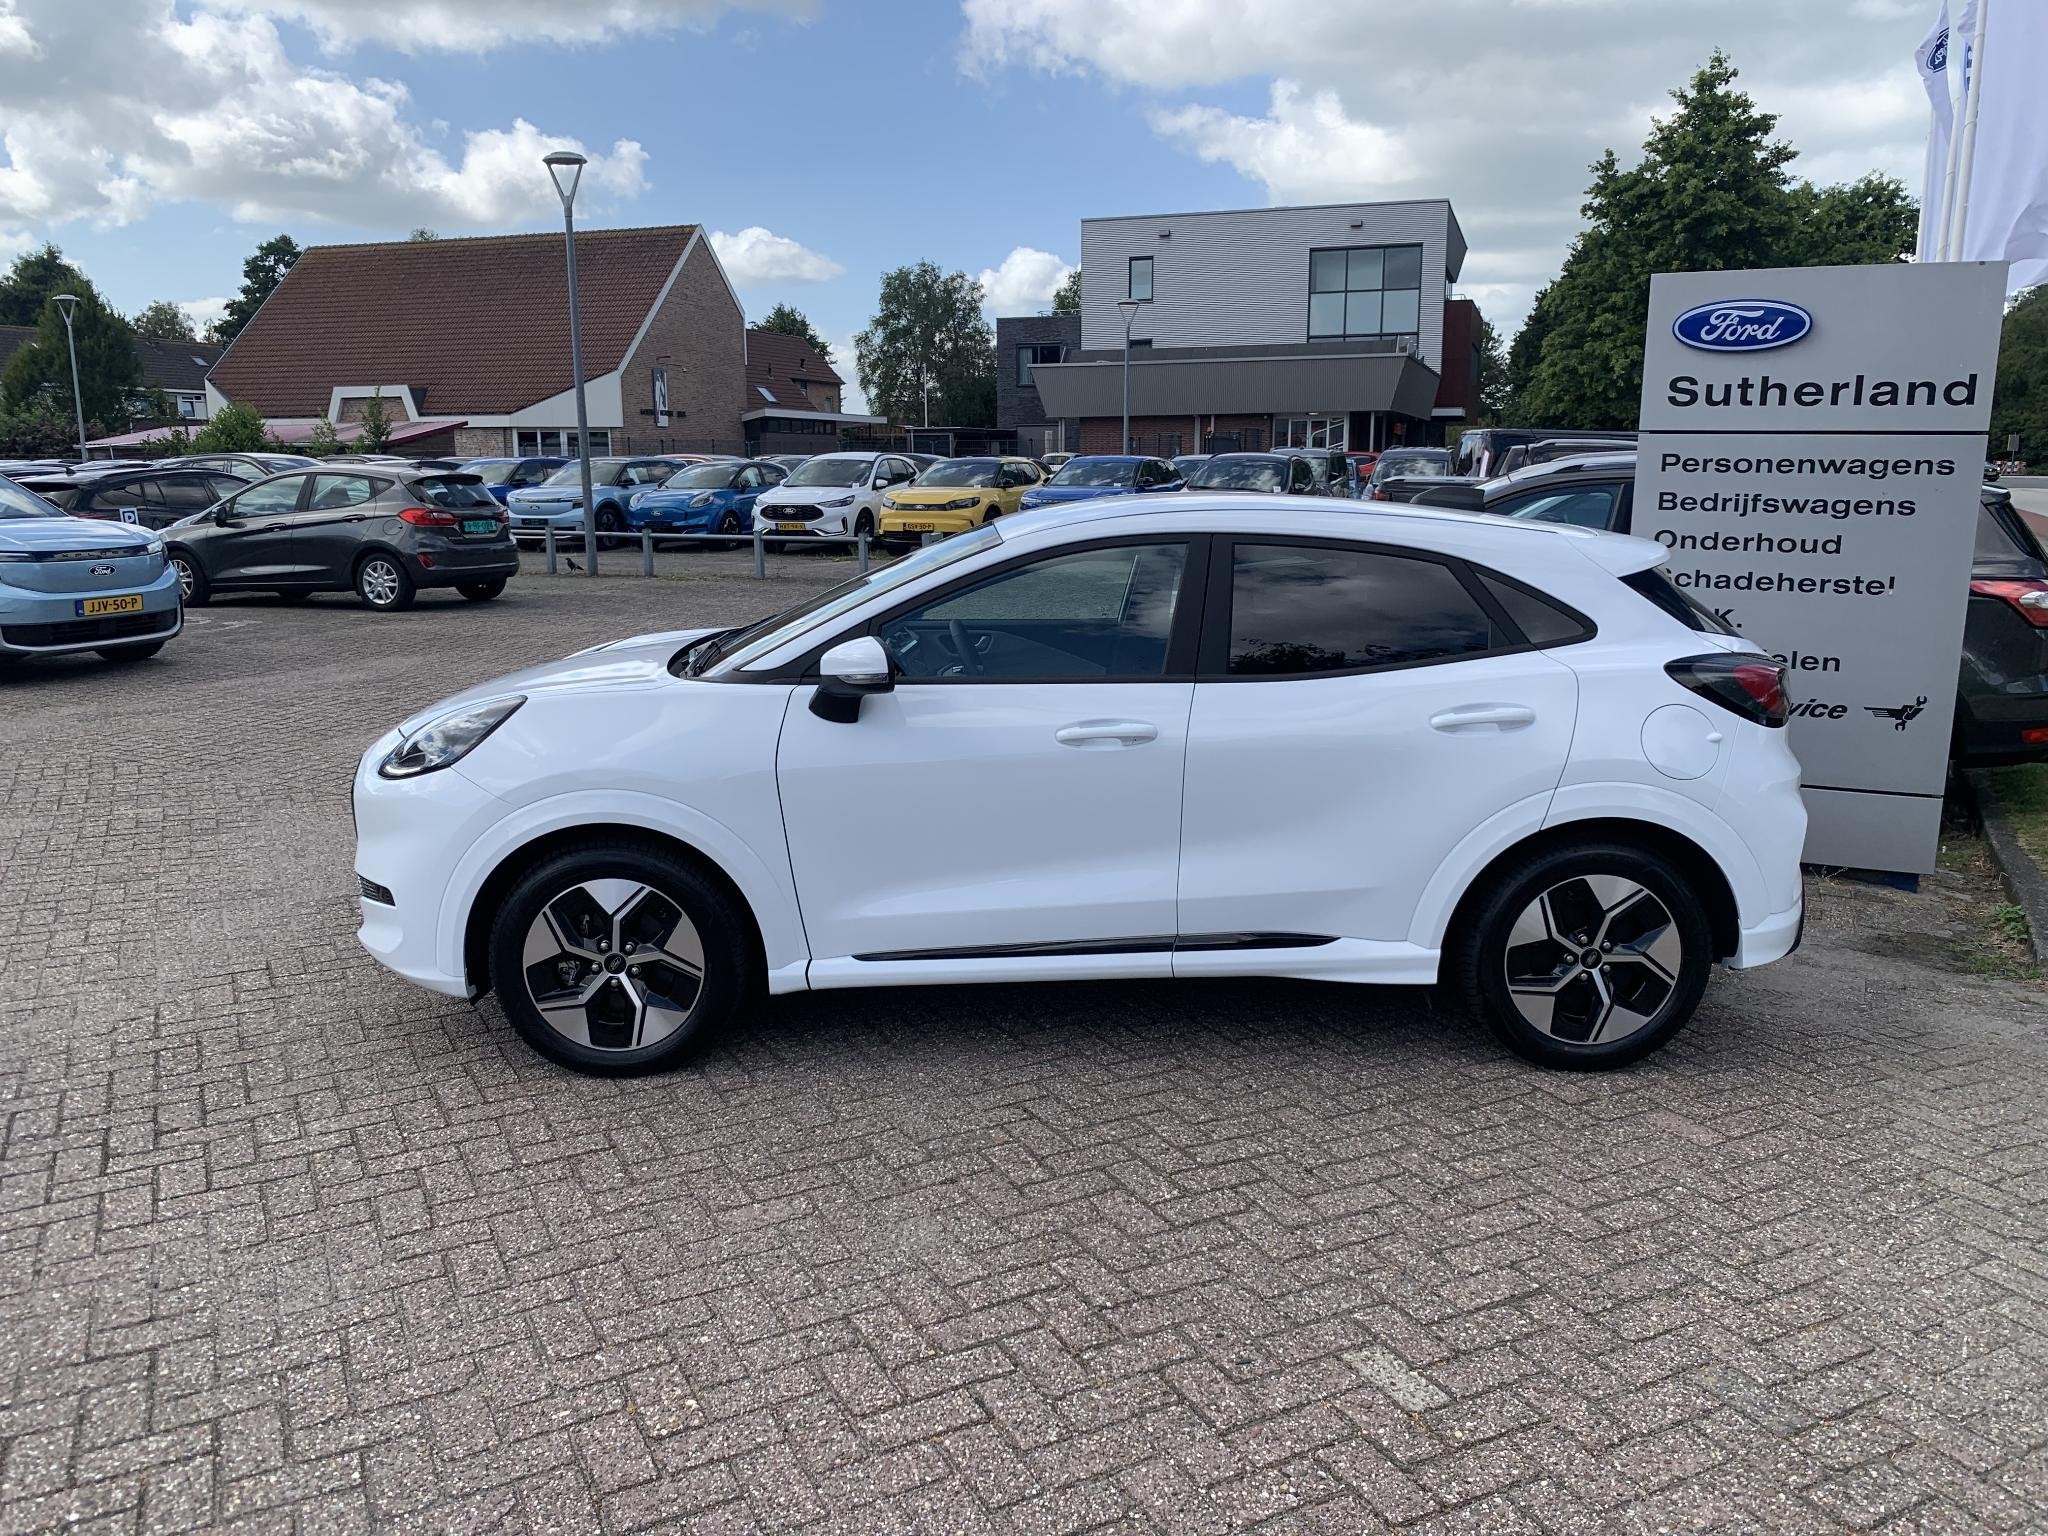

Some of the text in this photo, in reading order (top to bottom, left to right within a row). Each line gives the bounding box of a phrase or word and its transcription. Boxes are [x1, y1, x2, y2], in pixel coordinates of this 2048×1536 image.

[1700, 309, 1784, 341] Ford
[1667, 374, 1978, 407] Sutherland
[1661, 453, 1956, 480] Personenwagens
[1657, 492, 1917, 519] Bedrijfswagens
[1654, 529, 1842, 555] Onderhoud
[1666, 568, 1896, 595] chadeherstel
[89, 598, 138, 613] JJV-50-P
[1762, 648, 1841, 672] elen
